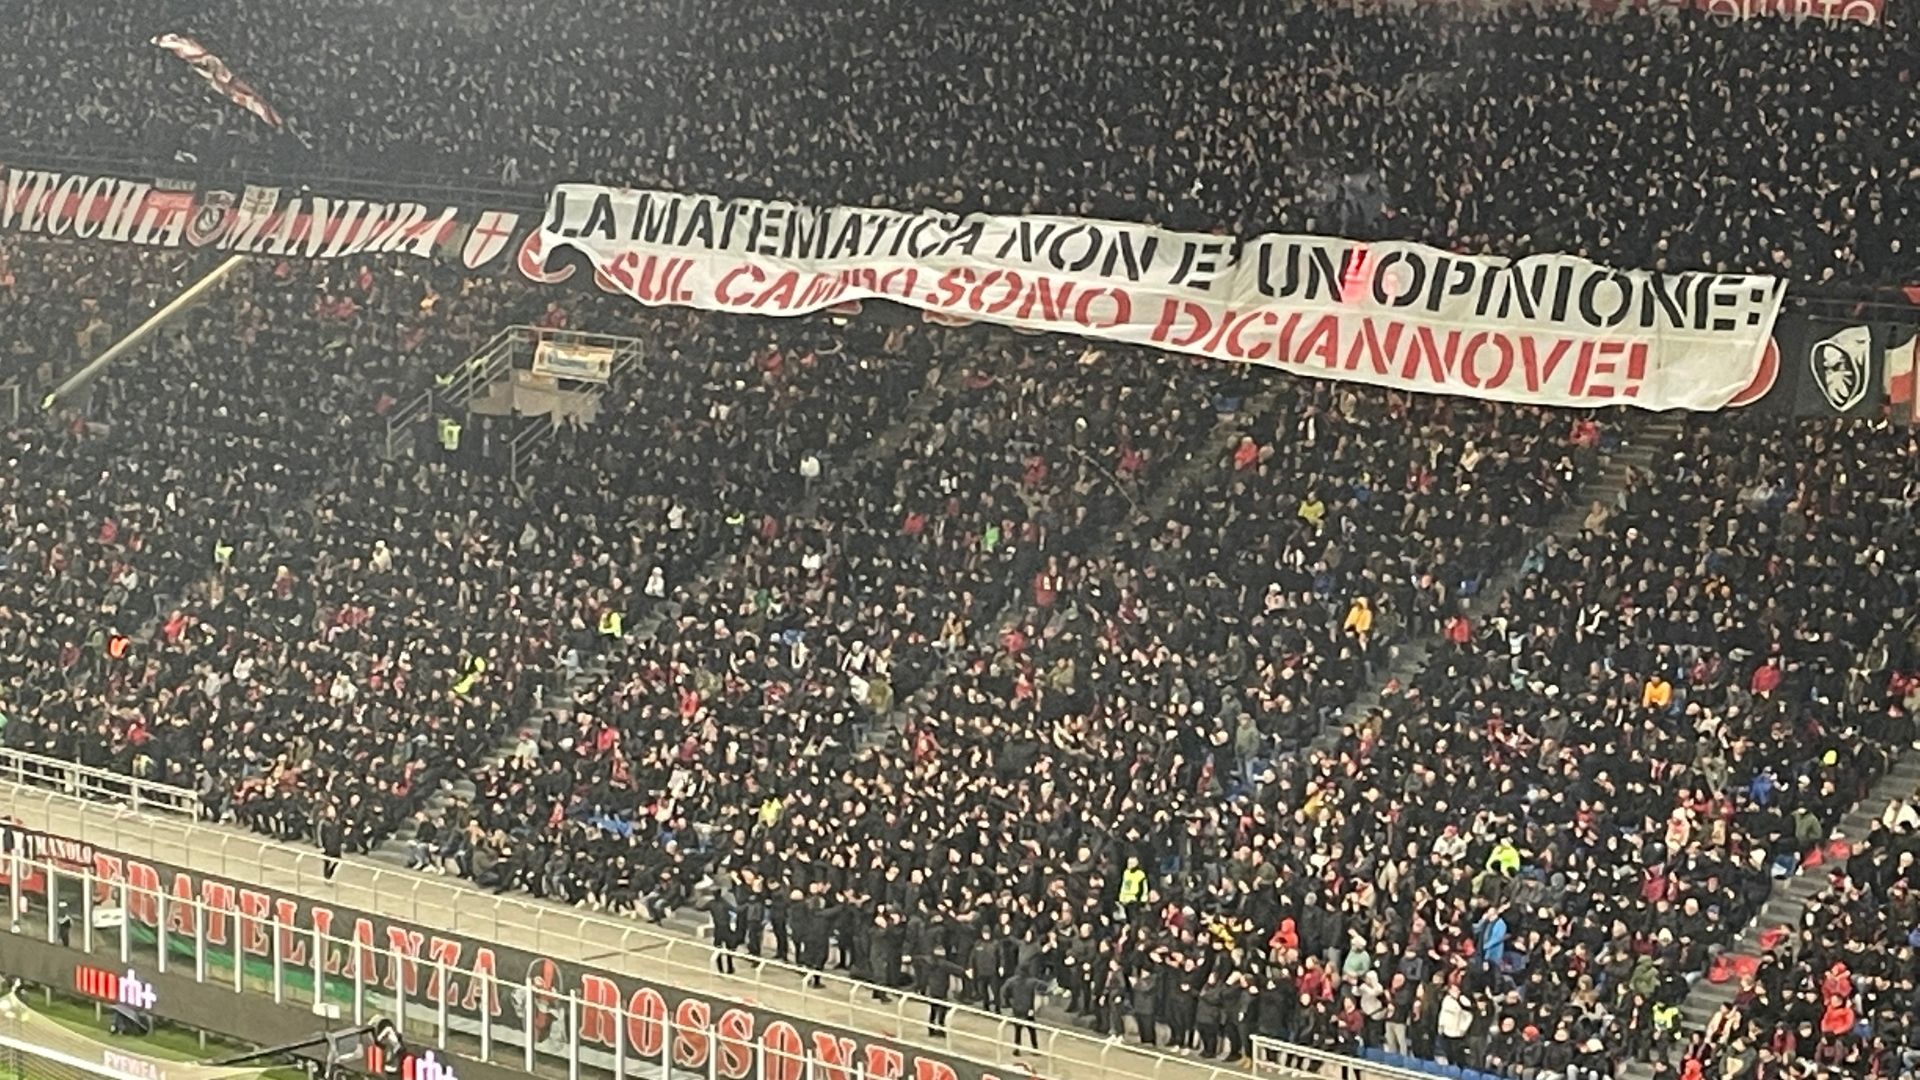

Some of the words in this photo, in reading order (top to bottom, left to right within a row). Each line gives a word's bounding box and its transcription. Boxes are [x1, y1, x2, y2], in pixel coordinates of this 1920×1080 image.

[2, 168, 189, 247] VECCHIA
[545, 191, 617, 240] LA
[631, 193, 985, 259] MATEMATICA
[995, 221, 1158, 282] NON
[603, 251, 696, 302] SUL
[926, 268, 1132, 329] SONO
[1150, 298, 1649, 398] DICIANNOVE!
[93, 852, 502, 1016] FRATELLANZA
